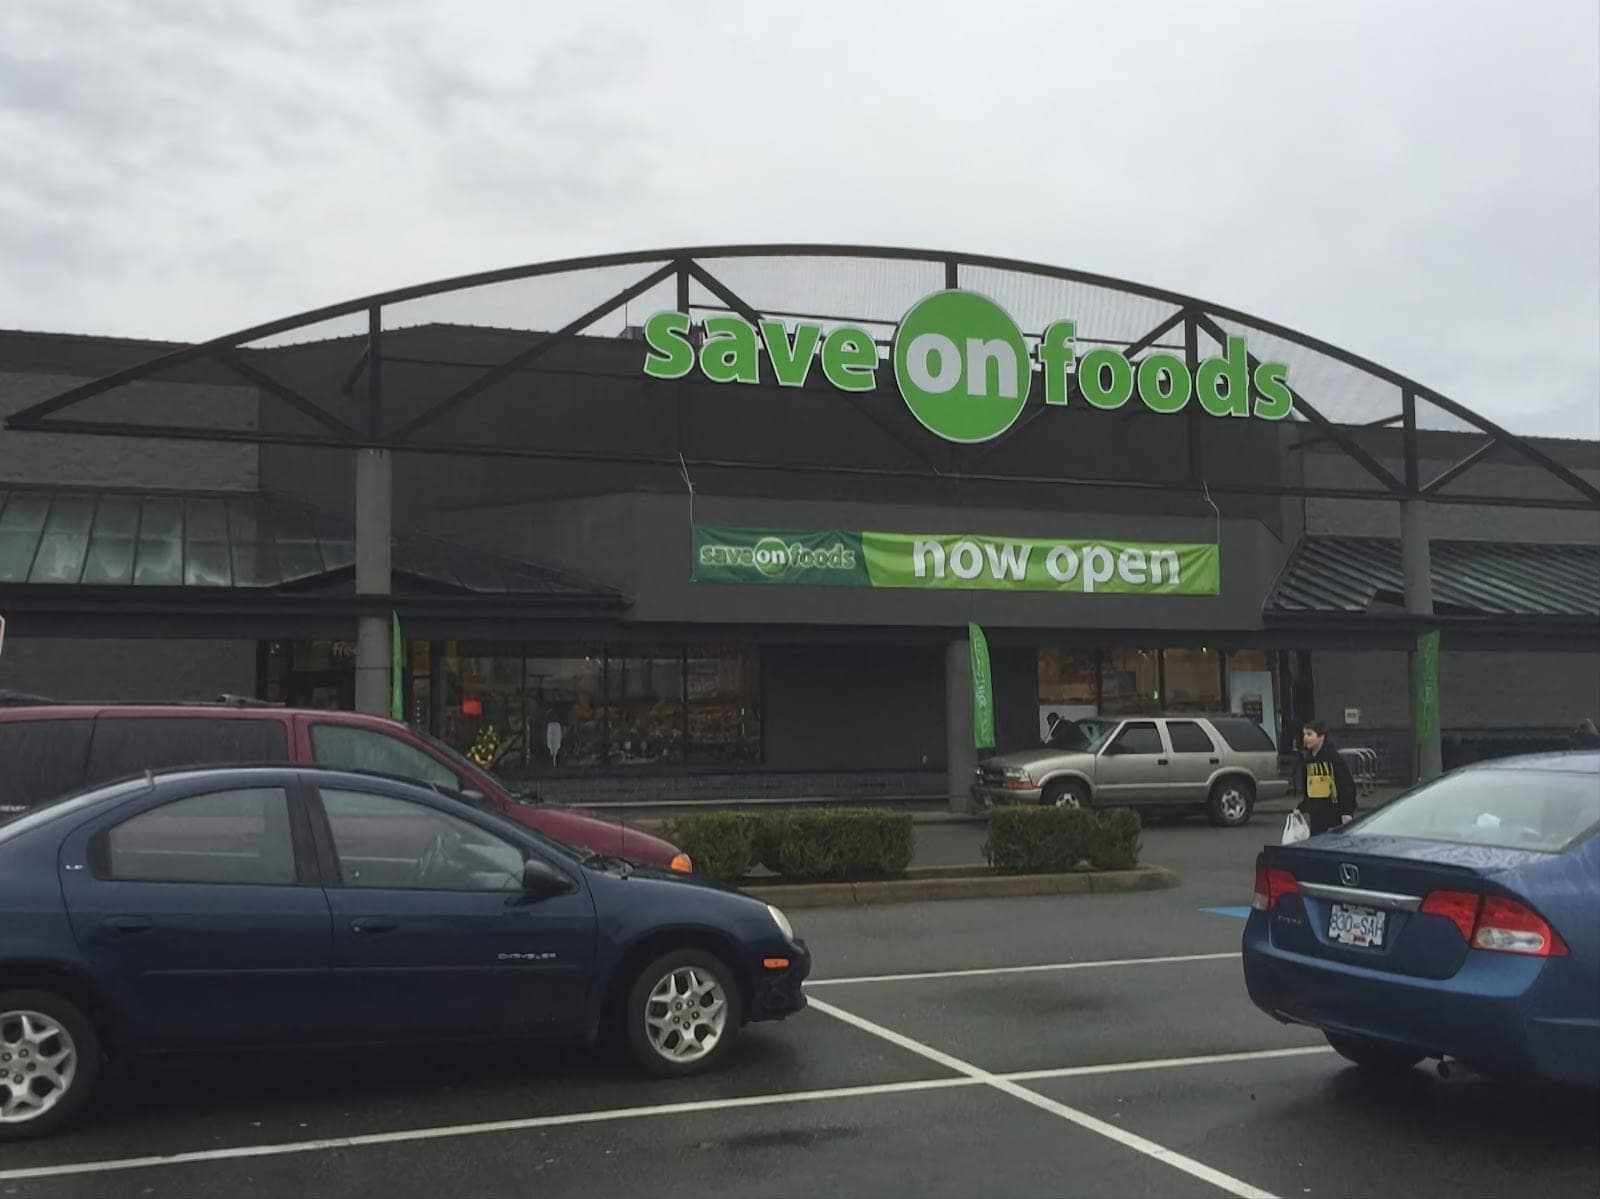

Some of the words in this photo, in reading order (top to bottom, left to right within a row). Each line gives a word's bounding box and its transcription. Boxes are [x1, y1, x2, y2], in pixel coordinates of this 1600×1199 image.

[643, 311, 879, 393] save
[906, 332, 1018, 398] on
[1036, 320, 1294, 420] foods
[699, 545, 757, 568] save
[757, 549, 787, 566] on
[790, 543, 857, 570] foods
[912, 538, 1033, 581] now
[1045, 546, 1181, 594] open
